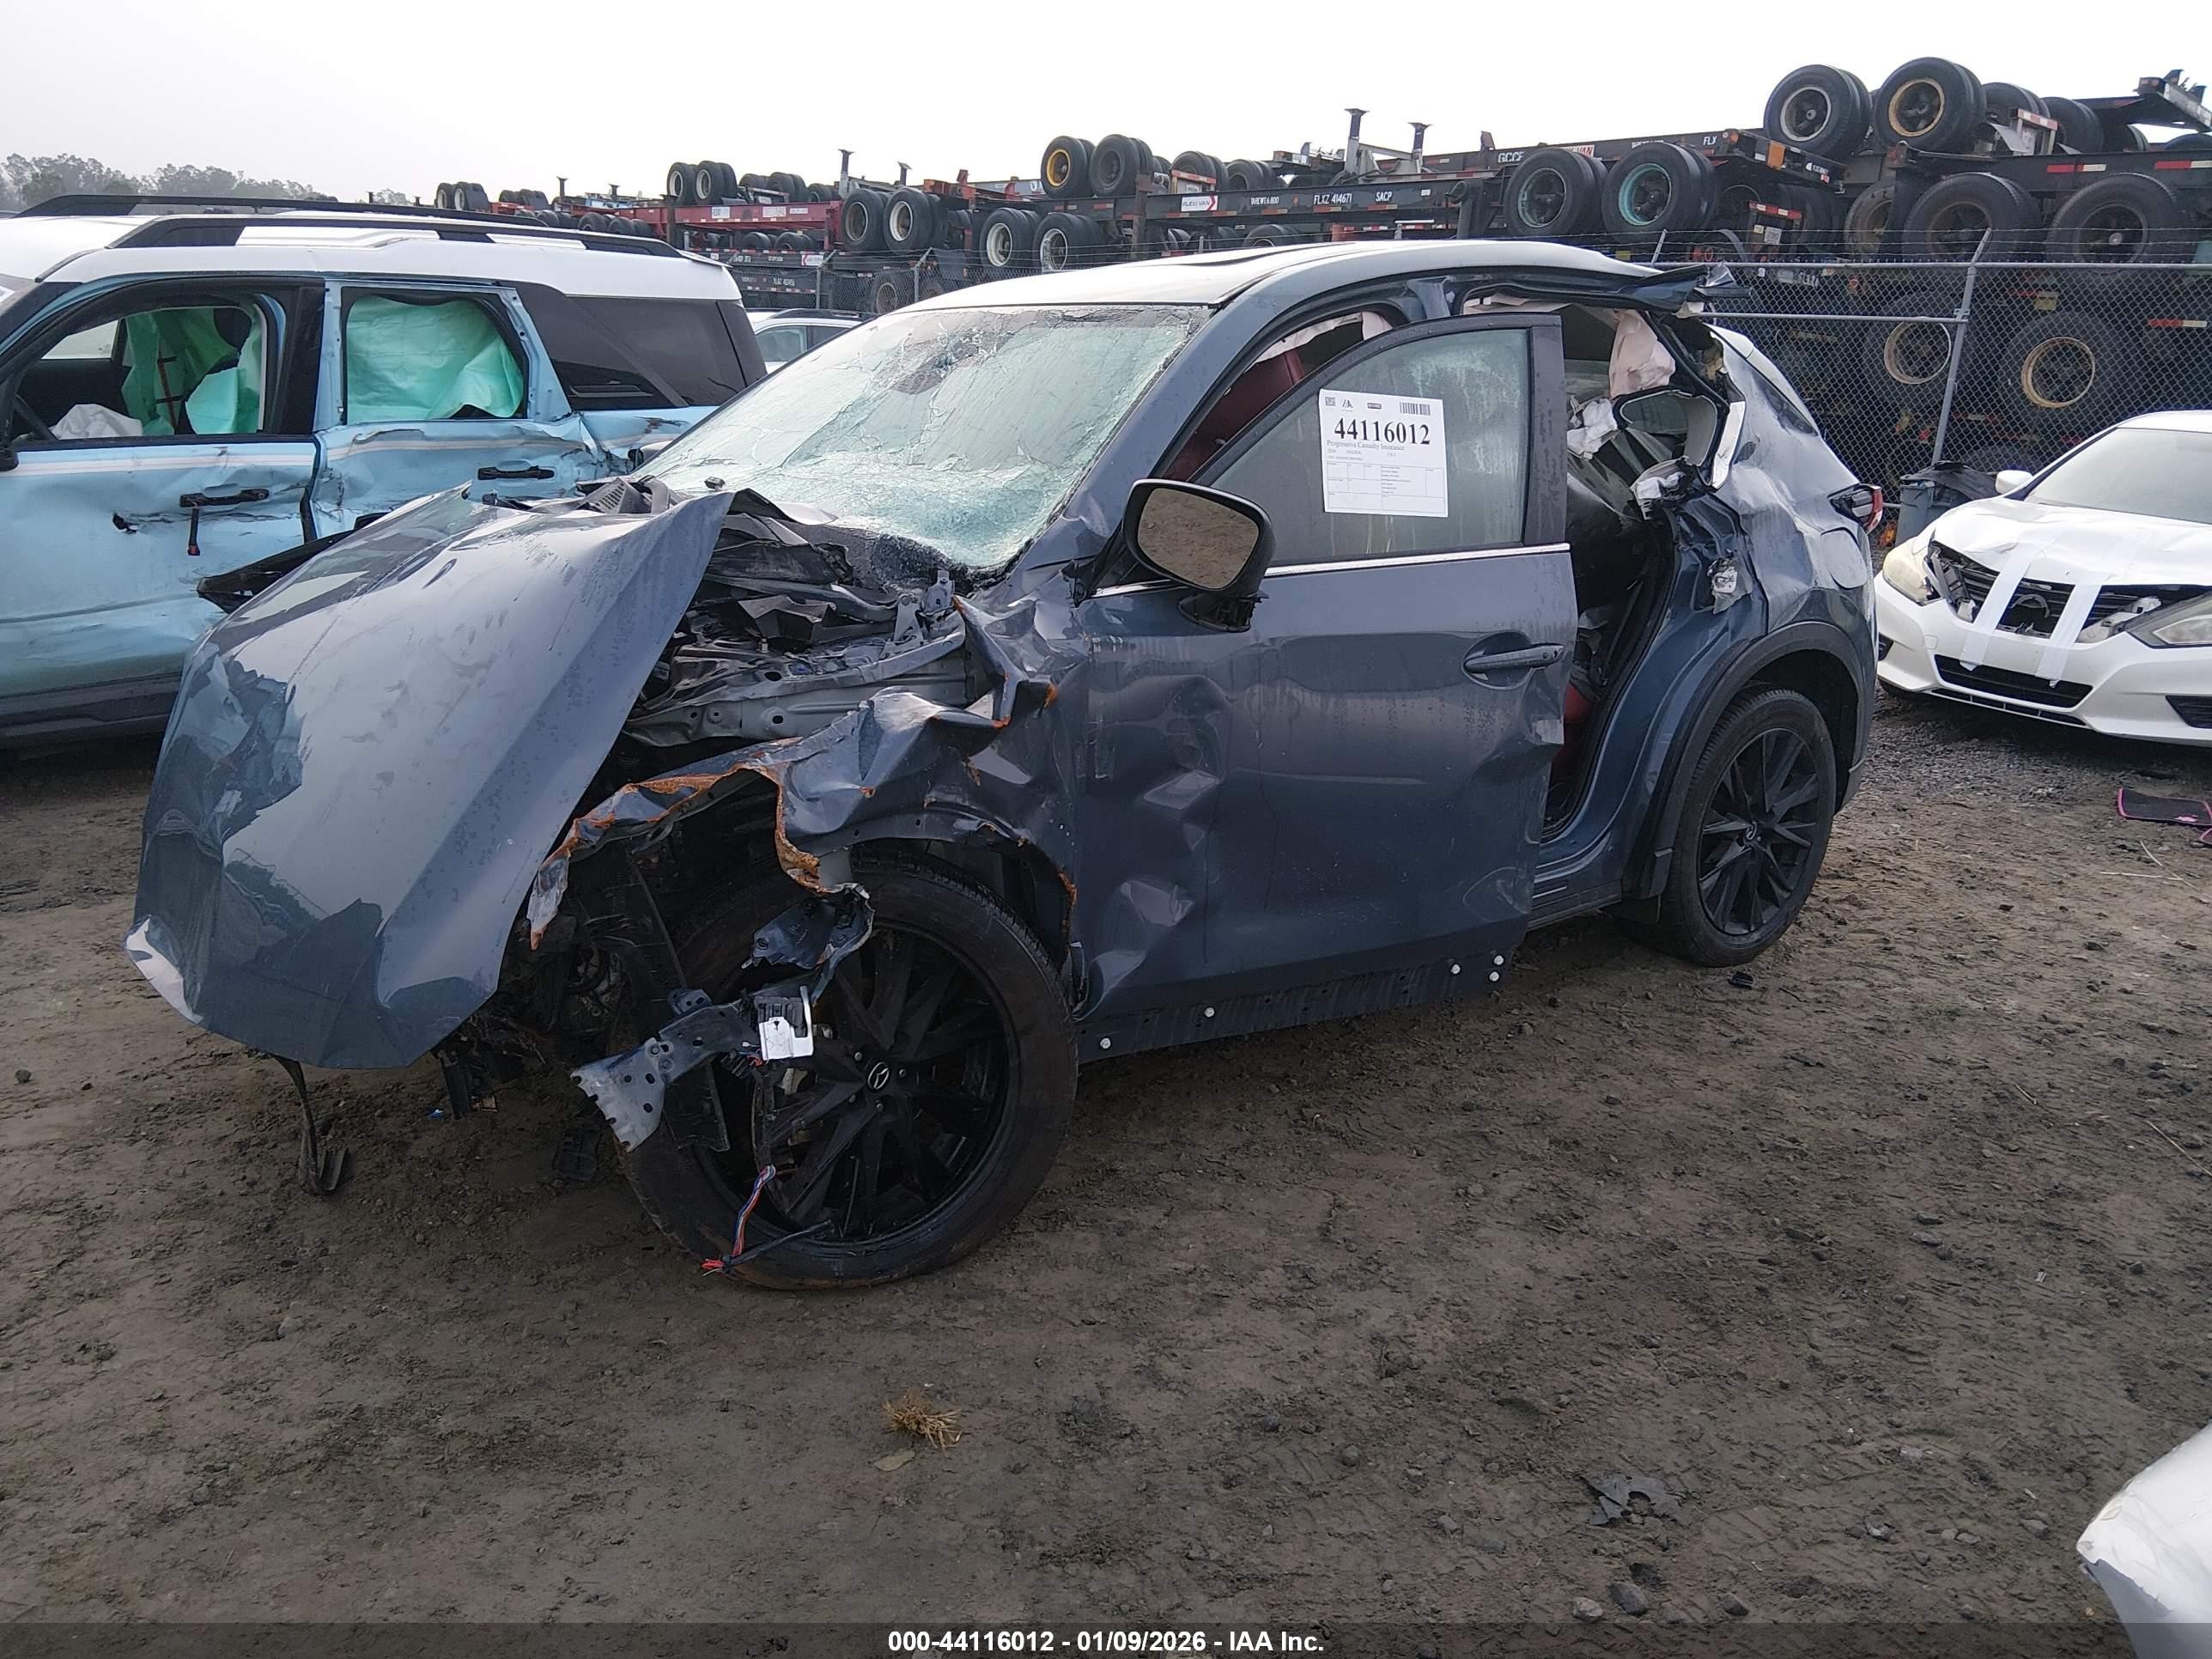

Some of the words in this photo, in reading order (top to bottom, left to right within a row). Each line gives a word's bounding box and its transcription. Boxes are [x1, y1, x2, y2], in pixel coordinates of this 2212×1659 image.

[1313, 194, 1329, 205] FLXZ
[1375, 191, 1392, 202] SACP
[1334, 417, 1431, 445] 44116012
